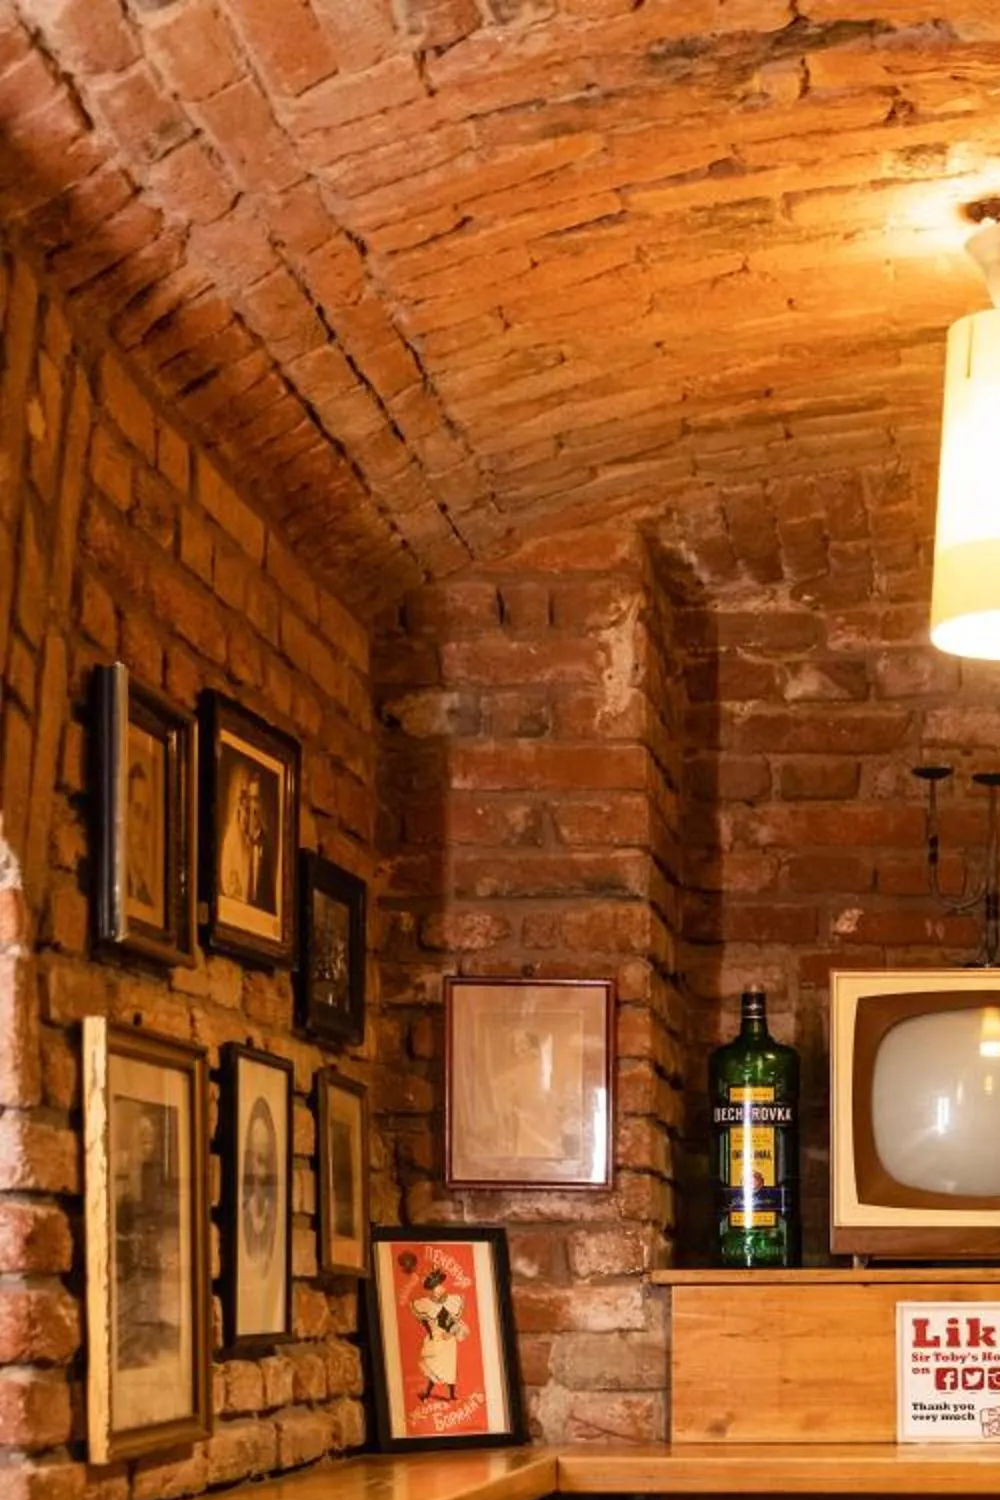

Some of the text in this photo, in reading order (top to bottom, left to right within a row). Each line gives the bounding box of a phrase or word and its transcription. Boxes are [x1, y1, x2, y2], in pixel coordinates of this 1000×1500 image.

[714, 1107, 793, 1123] BECHROVKA
[912, 1352, 930, 1362] Sir
[934, 1351, 978, 1365] Toby's
[912, 1367, 930, 1375] on
[912, 1402, 975, 1413] Thank you
[912, 1411, 975, 1423] very much
